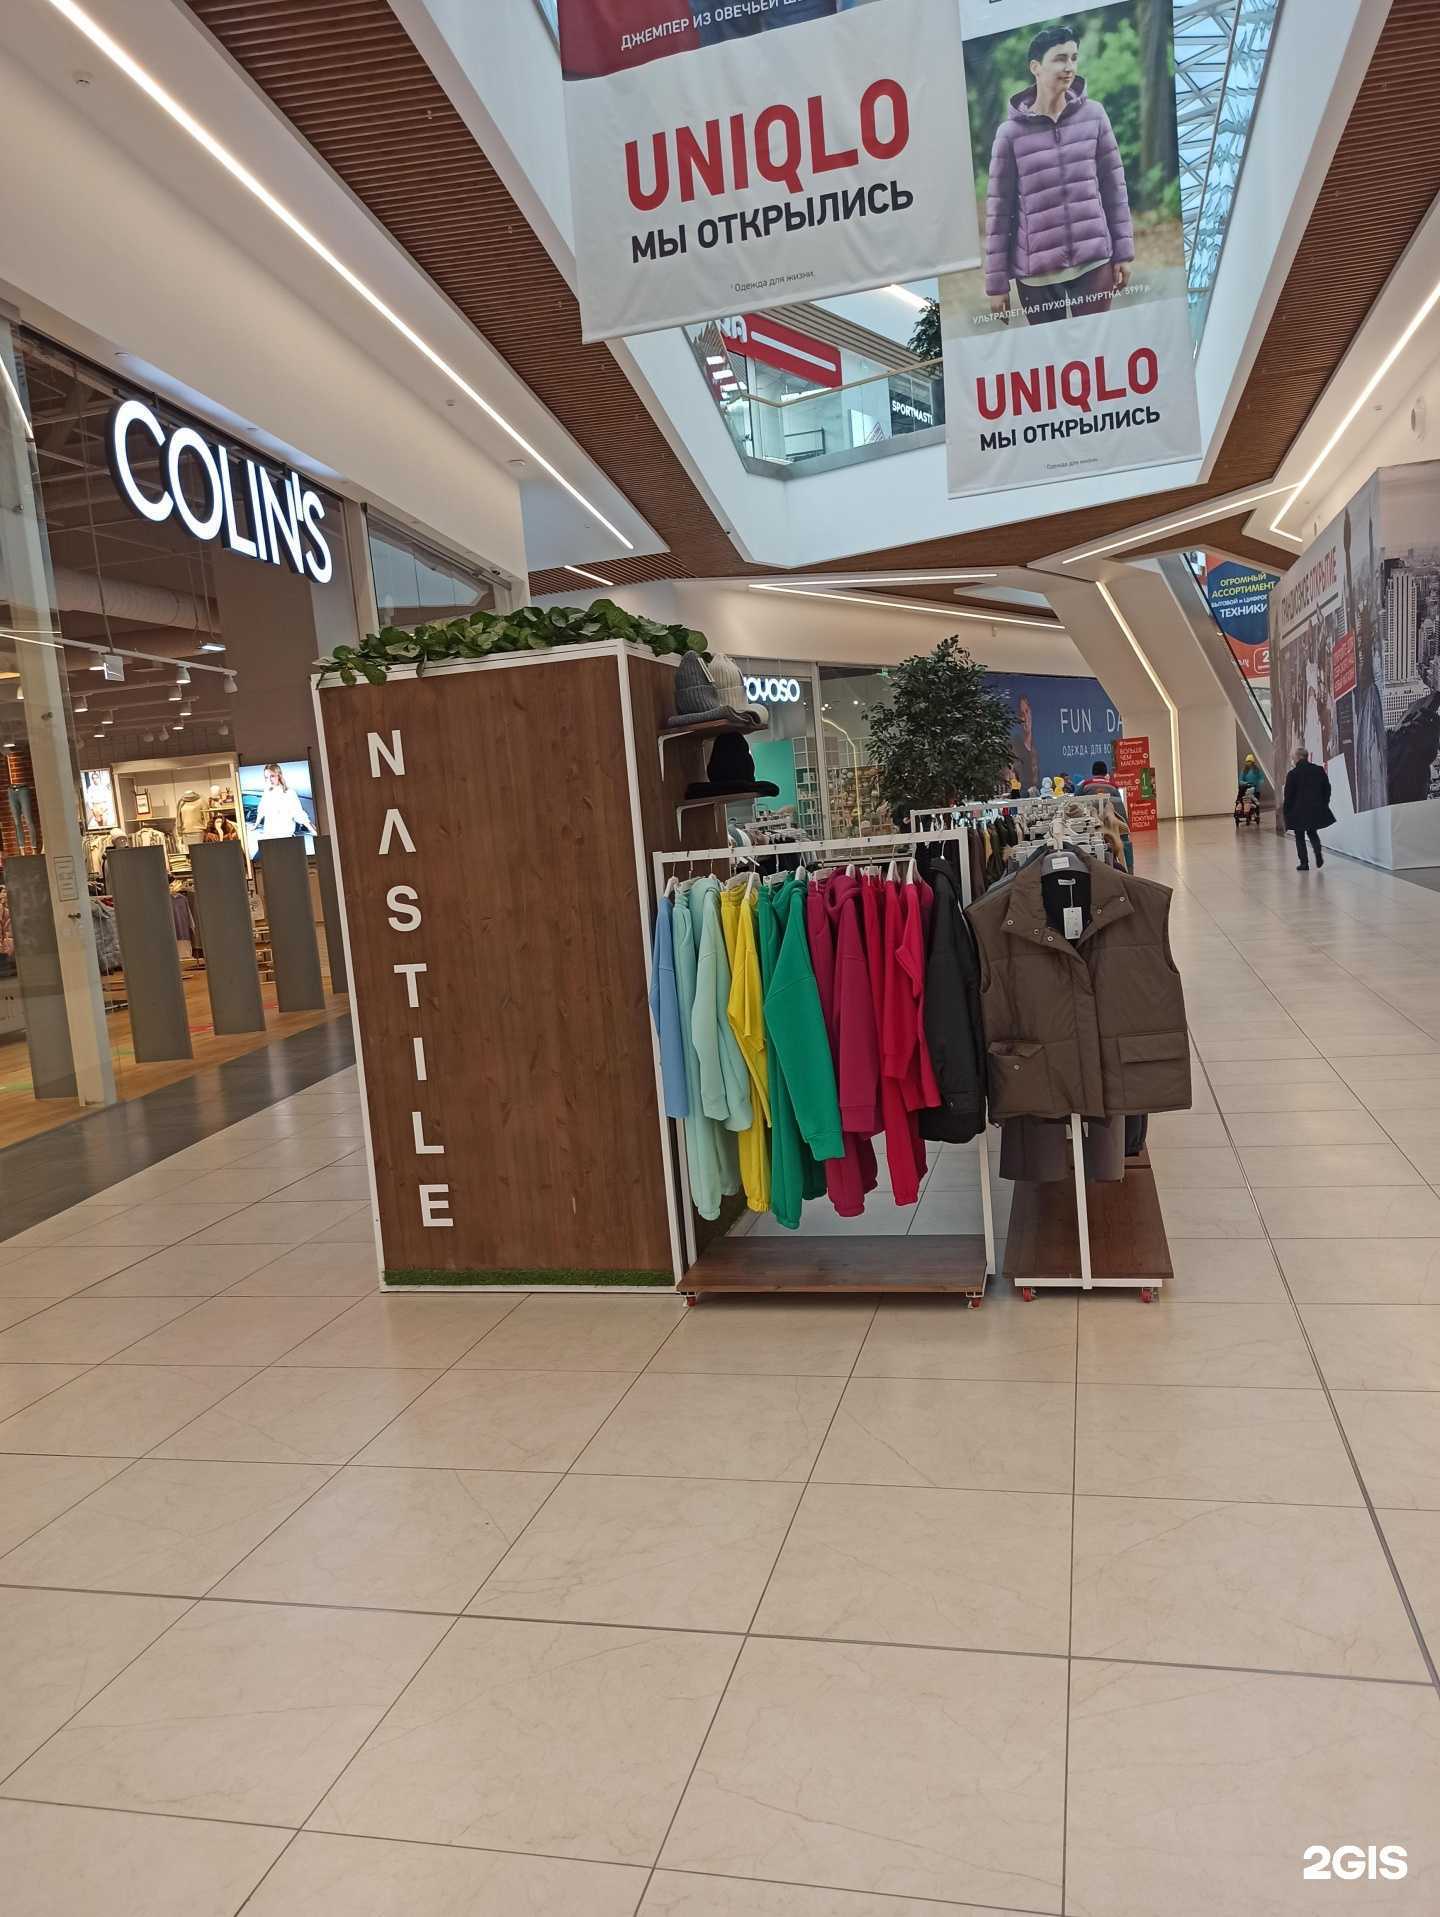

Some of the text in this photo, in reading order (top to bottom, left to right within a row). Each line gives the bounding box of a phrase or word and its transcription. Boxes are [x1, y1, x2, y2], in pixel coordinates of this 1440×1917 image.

[621, 18, 689, 51] ДЖЕМПЕР
[692, 14, 712, 29] ИЗ
[624, 78, 910, 211] UNIQLO
[631, 179, 914, 264] МЫ ОТКРЫЛИСЬ
[972, 304, 1040, 325] УЛЬТРАЛЕГКАЯ
[1042, 295, 1084, 312] ПУХОВАЯ
[1085, 289, 1122, 304] КУРТКА
[976, 347, 1159, 420] UNIQLO
[891, 400, 934, 425] SPORTMAST
[979, 405, 1161, 451] МЫ ОТКРЫЛИСЬ
[113, 400, 332, 583] COLIN'S
[1211, 581, 1276, 598] АССОРТИМЕНТ
[1220, 571, 1267, 587] ОГРОМНЫЙ
[1060, 708, 1092, 734] FUN
[366, 729, 454, 1228] NASTILE
